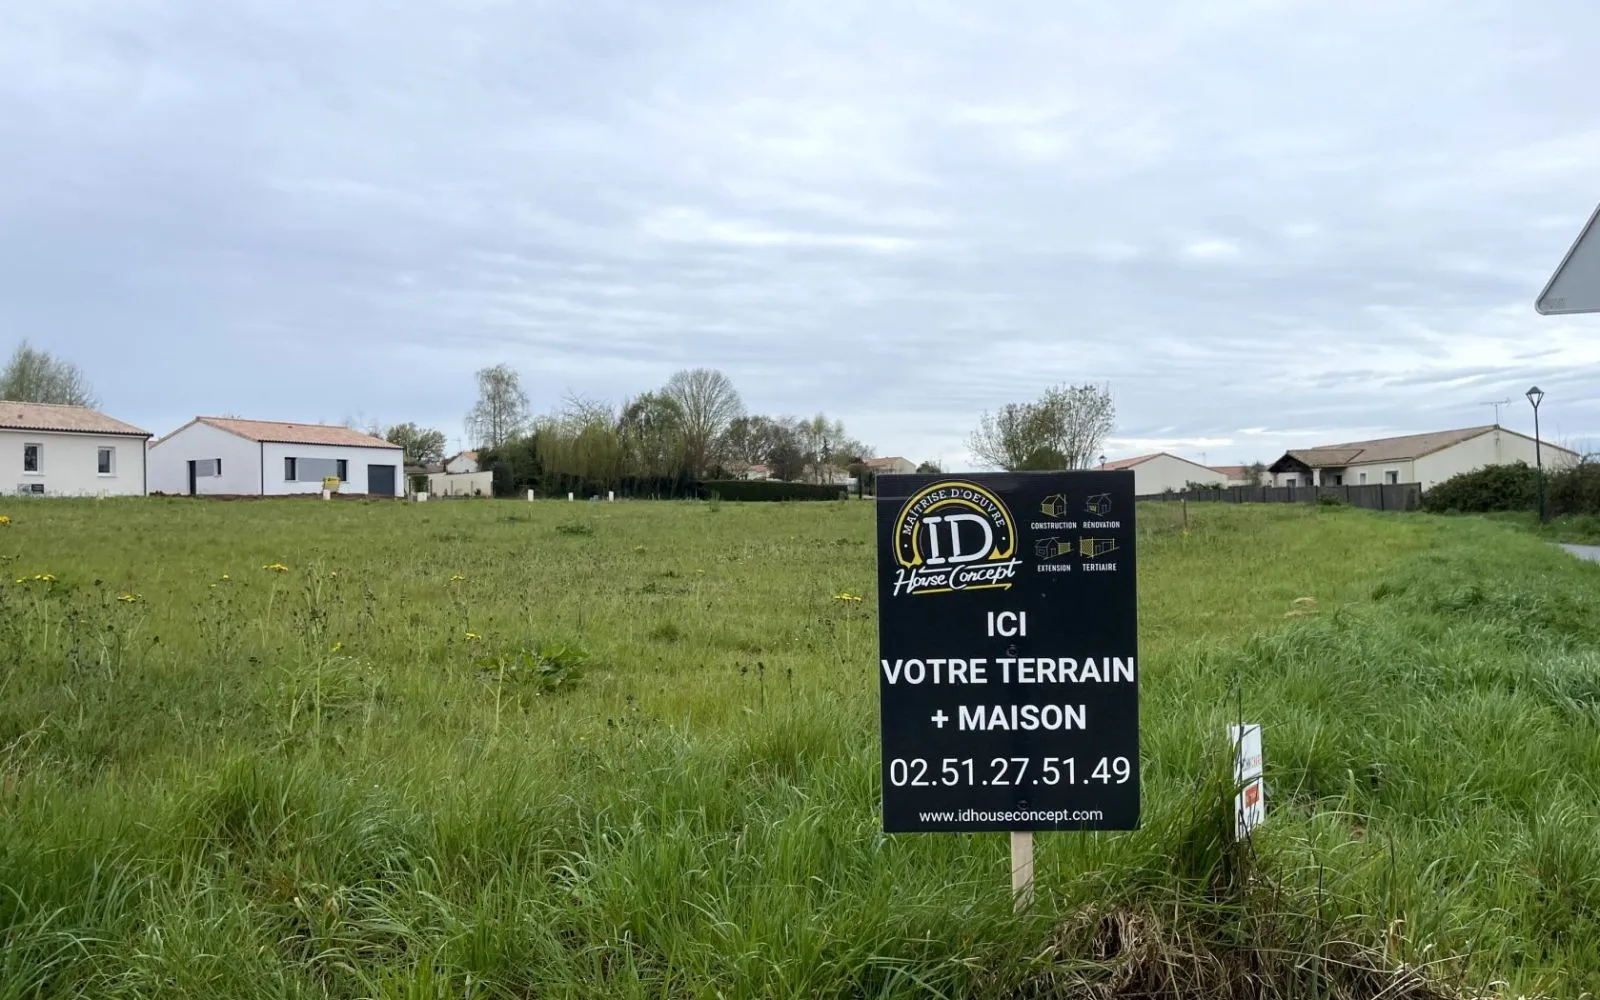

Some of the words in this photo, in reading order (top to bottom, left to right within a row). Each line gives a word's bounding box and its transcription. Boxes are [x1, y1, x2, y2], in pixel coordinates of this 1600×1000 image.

[950, 488, 1006, 528] D'OEUVRE
[922, 513, 993, 565] ID
[1030, 521, 1077, 530] CONSTRUCTION
[893, 568, 948, 597] House
[948, 557, 1023, 590] Concept
[1037, 564, 1071, 573] EXTENSION
[1082, 562, 1117, 572] TERTIAIRE
[987, 611, 1027, 637] ICI
[881, 658, 988, 685] VOTRE
[995, 656, 1135, 684] TERRAIN
[931, 709, 949, 729] +
[958, 704, 1087, 731] MAISON
[889, 756, 1131, 787] 02.51.27.51.49
[919, 808, 1104, 824] www.idhouseconcept.com
